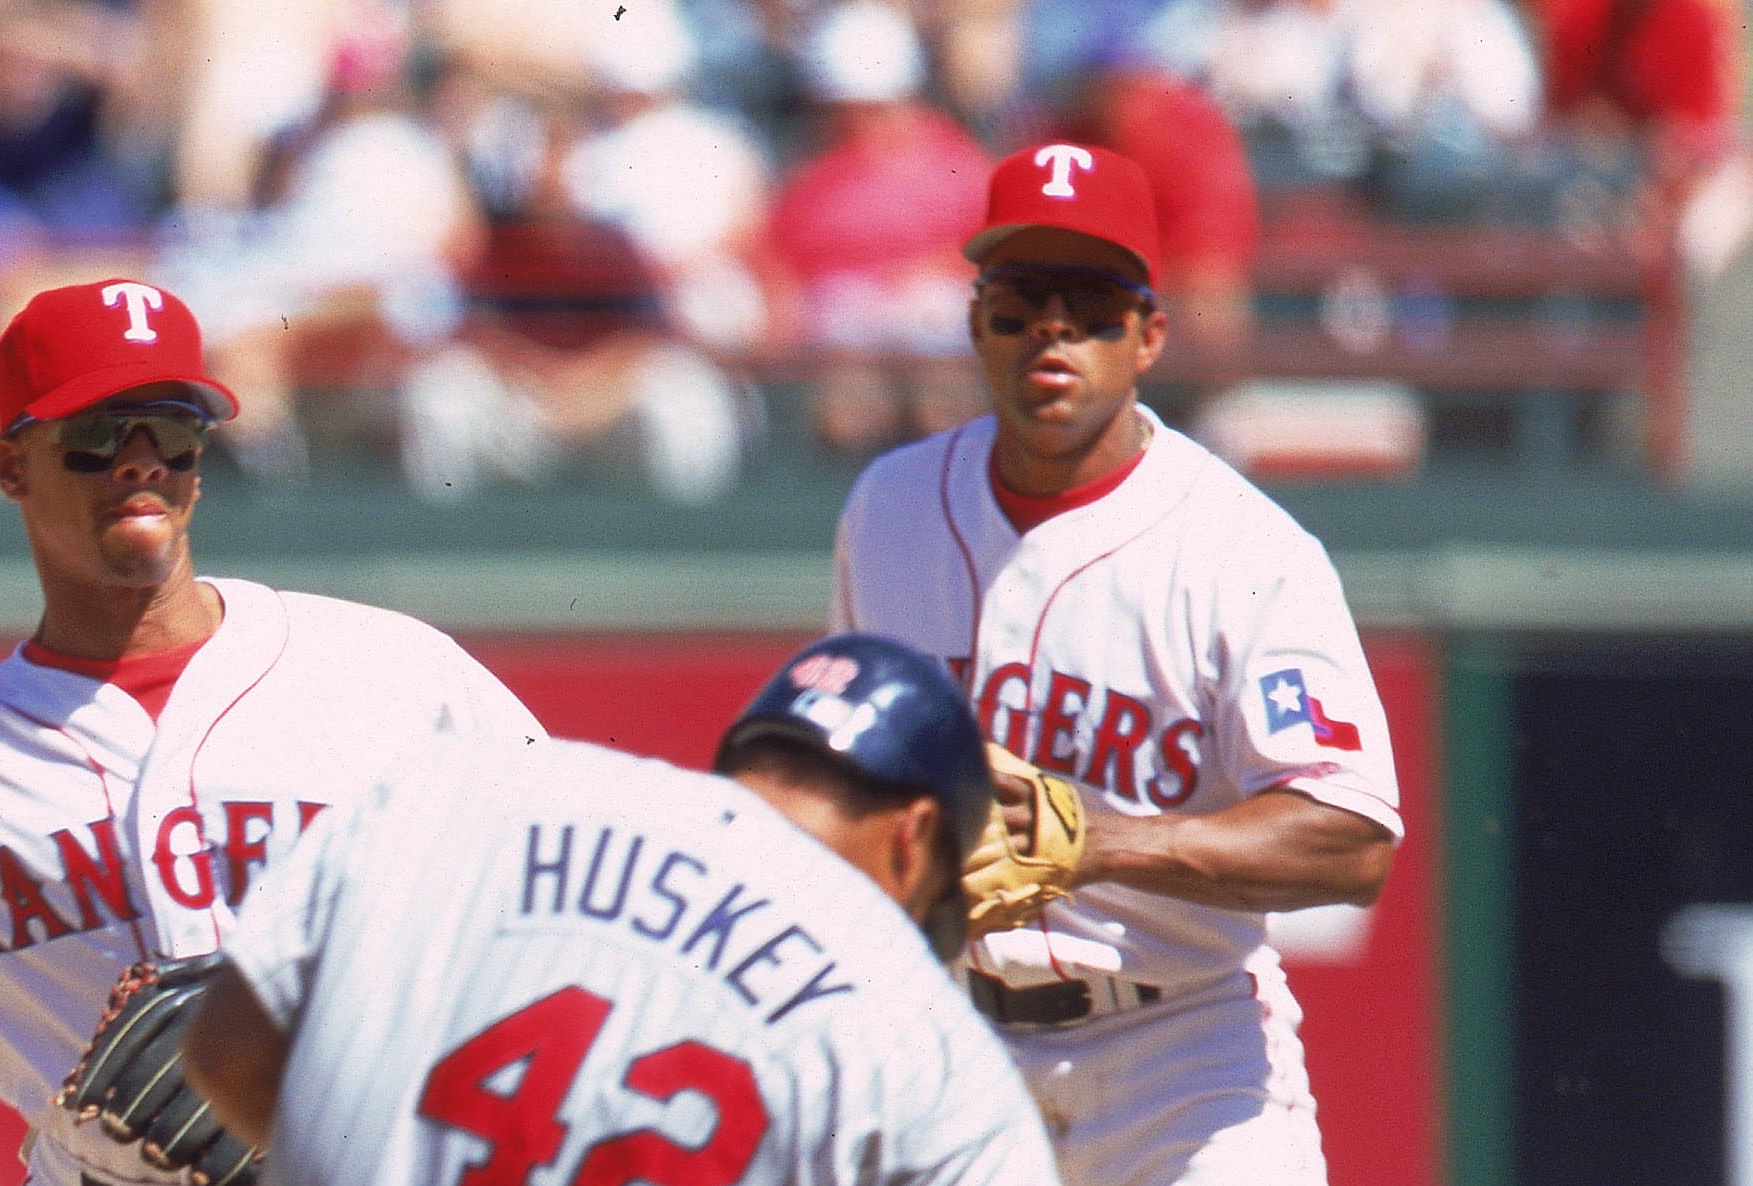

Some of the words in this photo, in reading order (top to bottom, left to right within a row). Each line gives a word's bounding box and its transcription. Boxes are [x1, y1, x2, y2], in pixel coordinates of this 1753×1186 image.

[1033, 143, 1093, 198] T
[101, 281, 164, 344] T
[947, 656, 1206, 809] GERS
[519, 823, 856, 1026] HUSKEY
